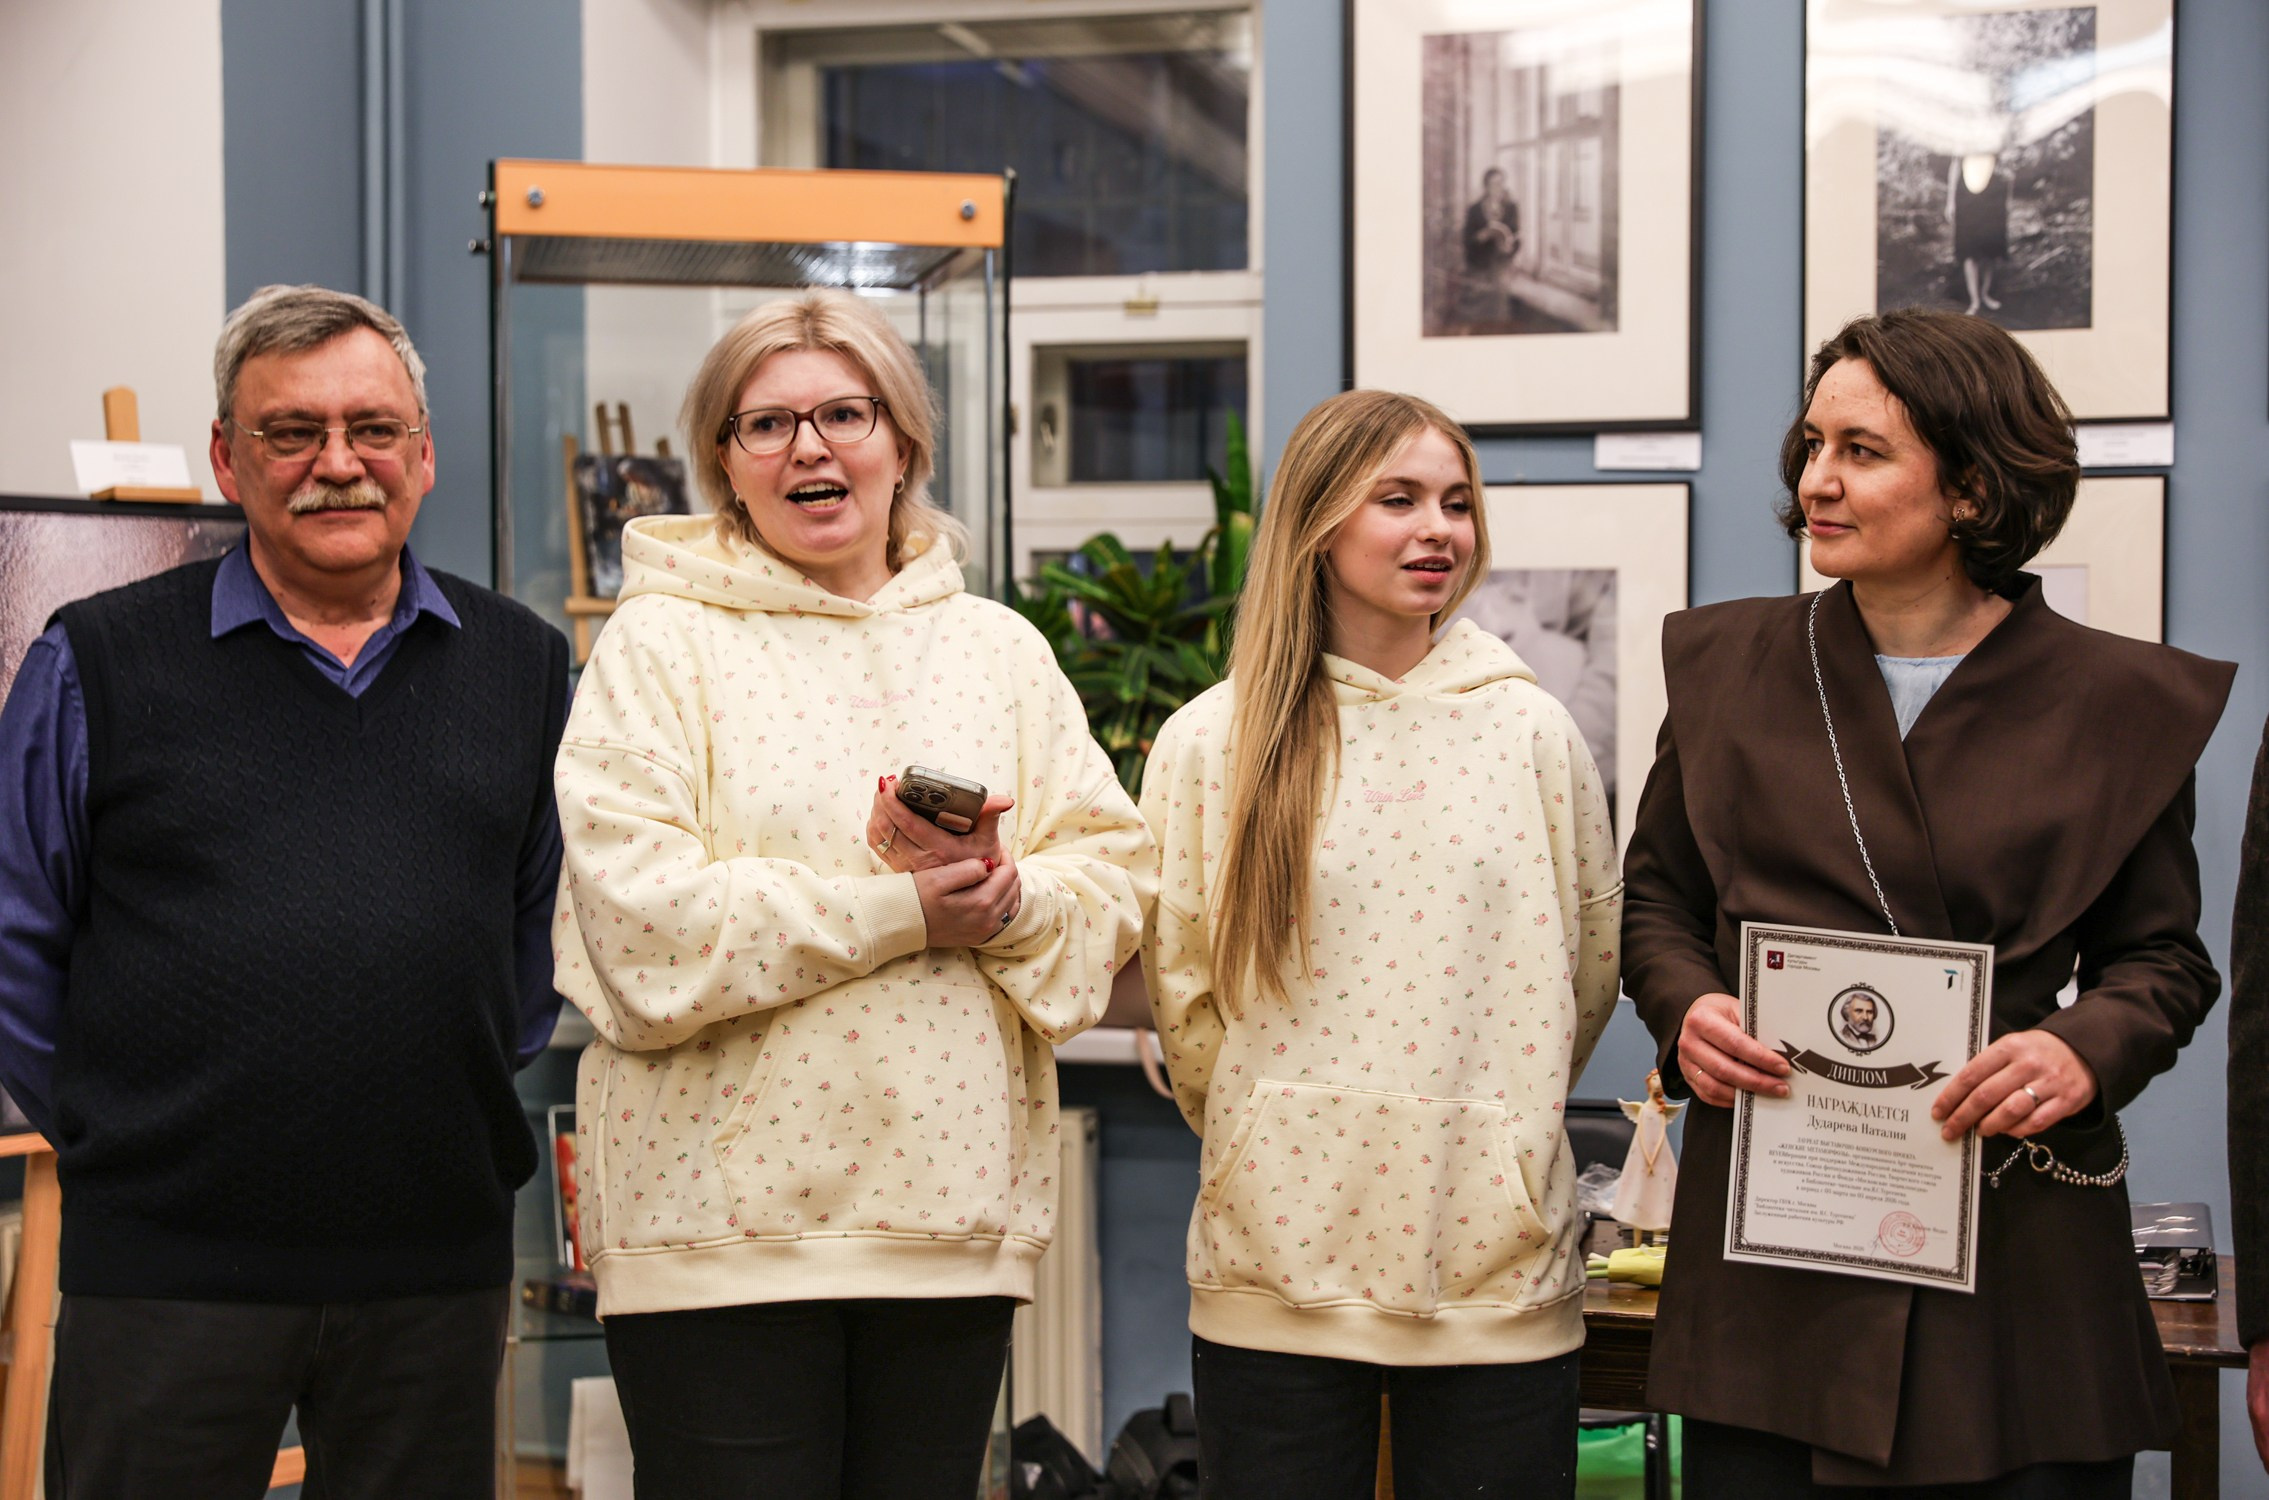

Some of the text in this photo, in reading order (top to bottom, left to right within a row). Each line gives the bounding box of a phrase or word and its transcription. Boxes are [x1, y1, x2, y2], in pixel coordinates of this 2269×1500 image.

[1364, 787, 1425, 803] With Love
[1827, 1062, 1889, 1086] ДИПЛОМ
[1807, 1094, 1910, 1123] НАГРАЖДАЕТСЯ
[1806, 1115, 1907, 1142] Дударева Наталия
